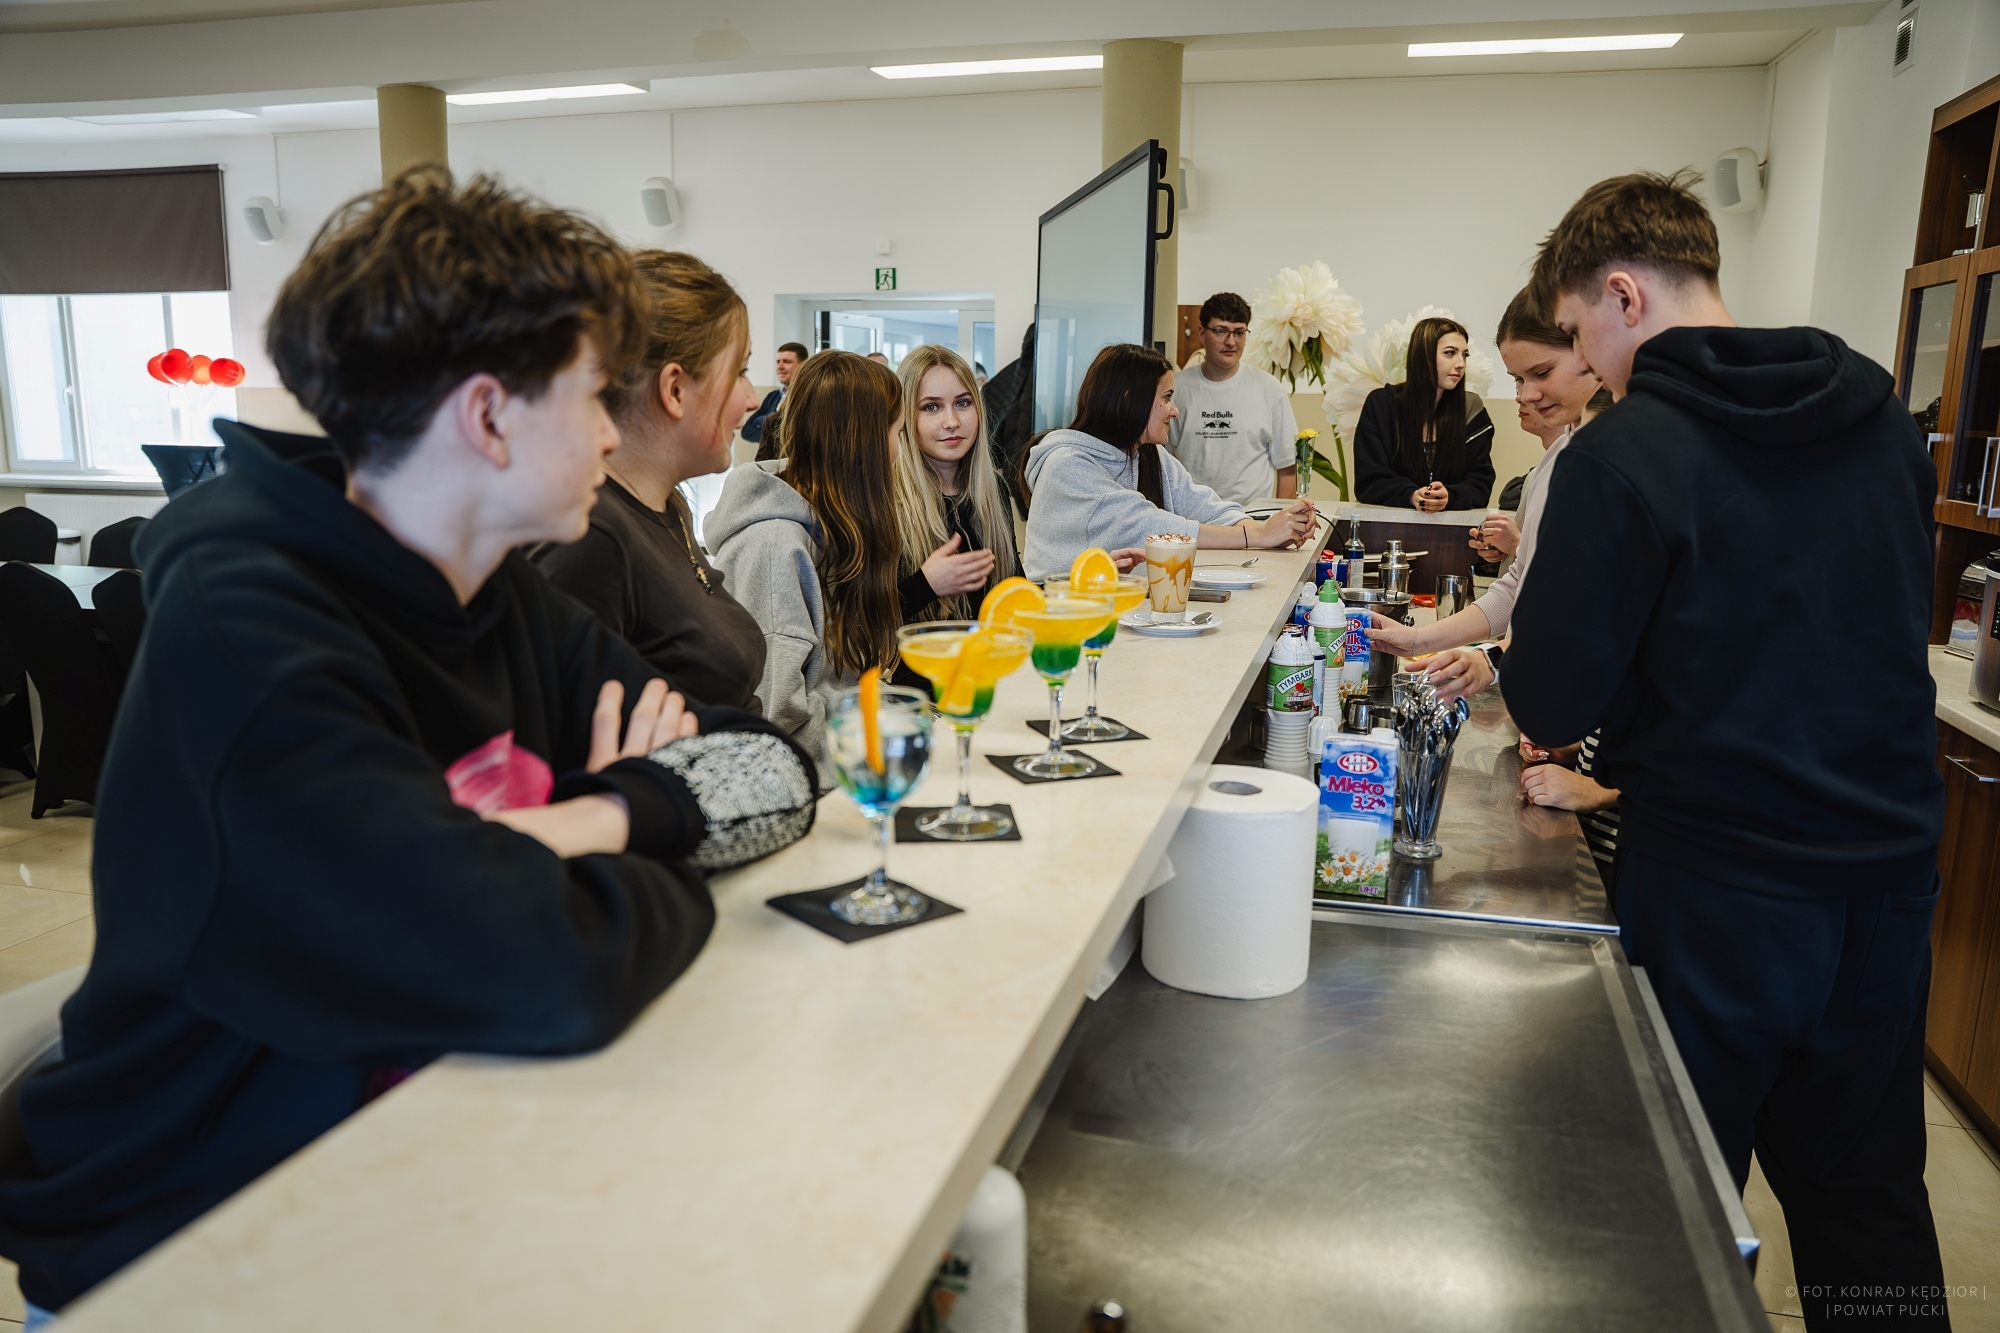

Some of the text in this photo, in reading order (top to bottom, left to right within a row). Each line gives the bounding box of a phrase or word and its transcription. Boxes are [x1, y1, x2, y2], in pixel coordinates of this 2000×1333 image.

[1201, 410, 1234, 419] Red Bulls
[1346, 644, 1367, 656] 3,2%
[1327, 775, 1385, 796] Mleko
[1352, 795, 1386, 811] 3,2%
